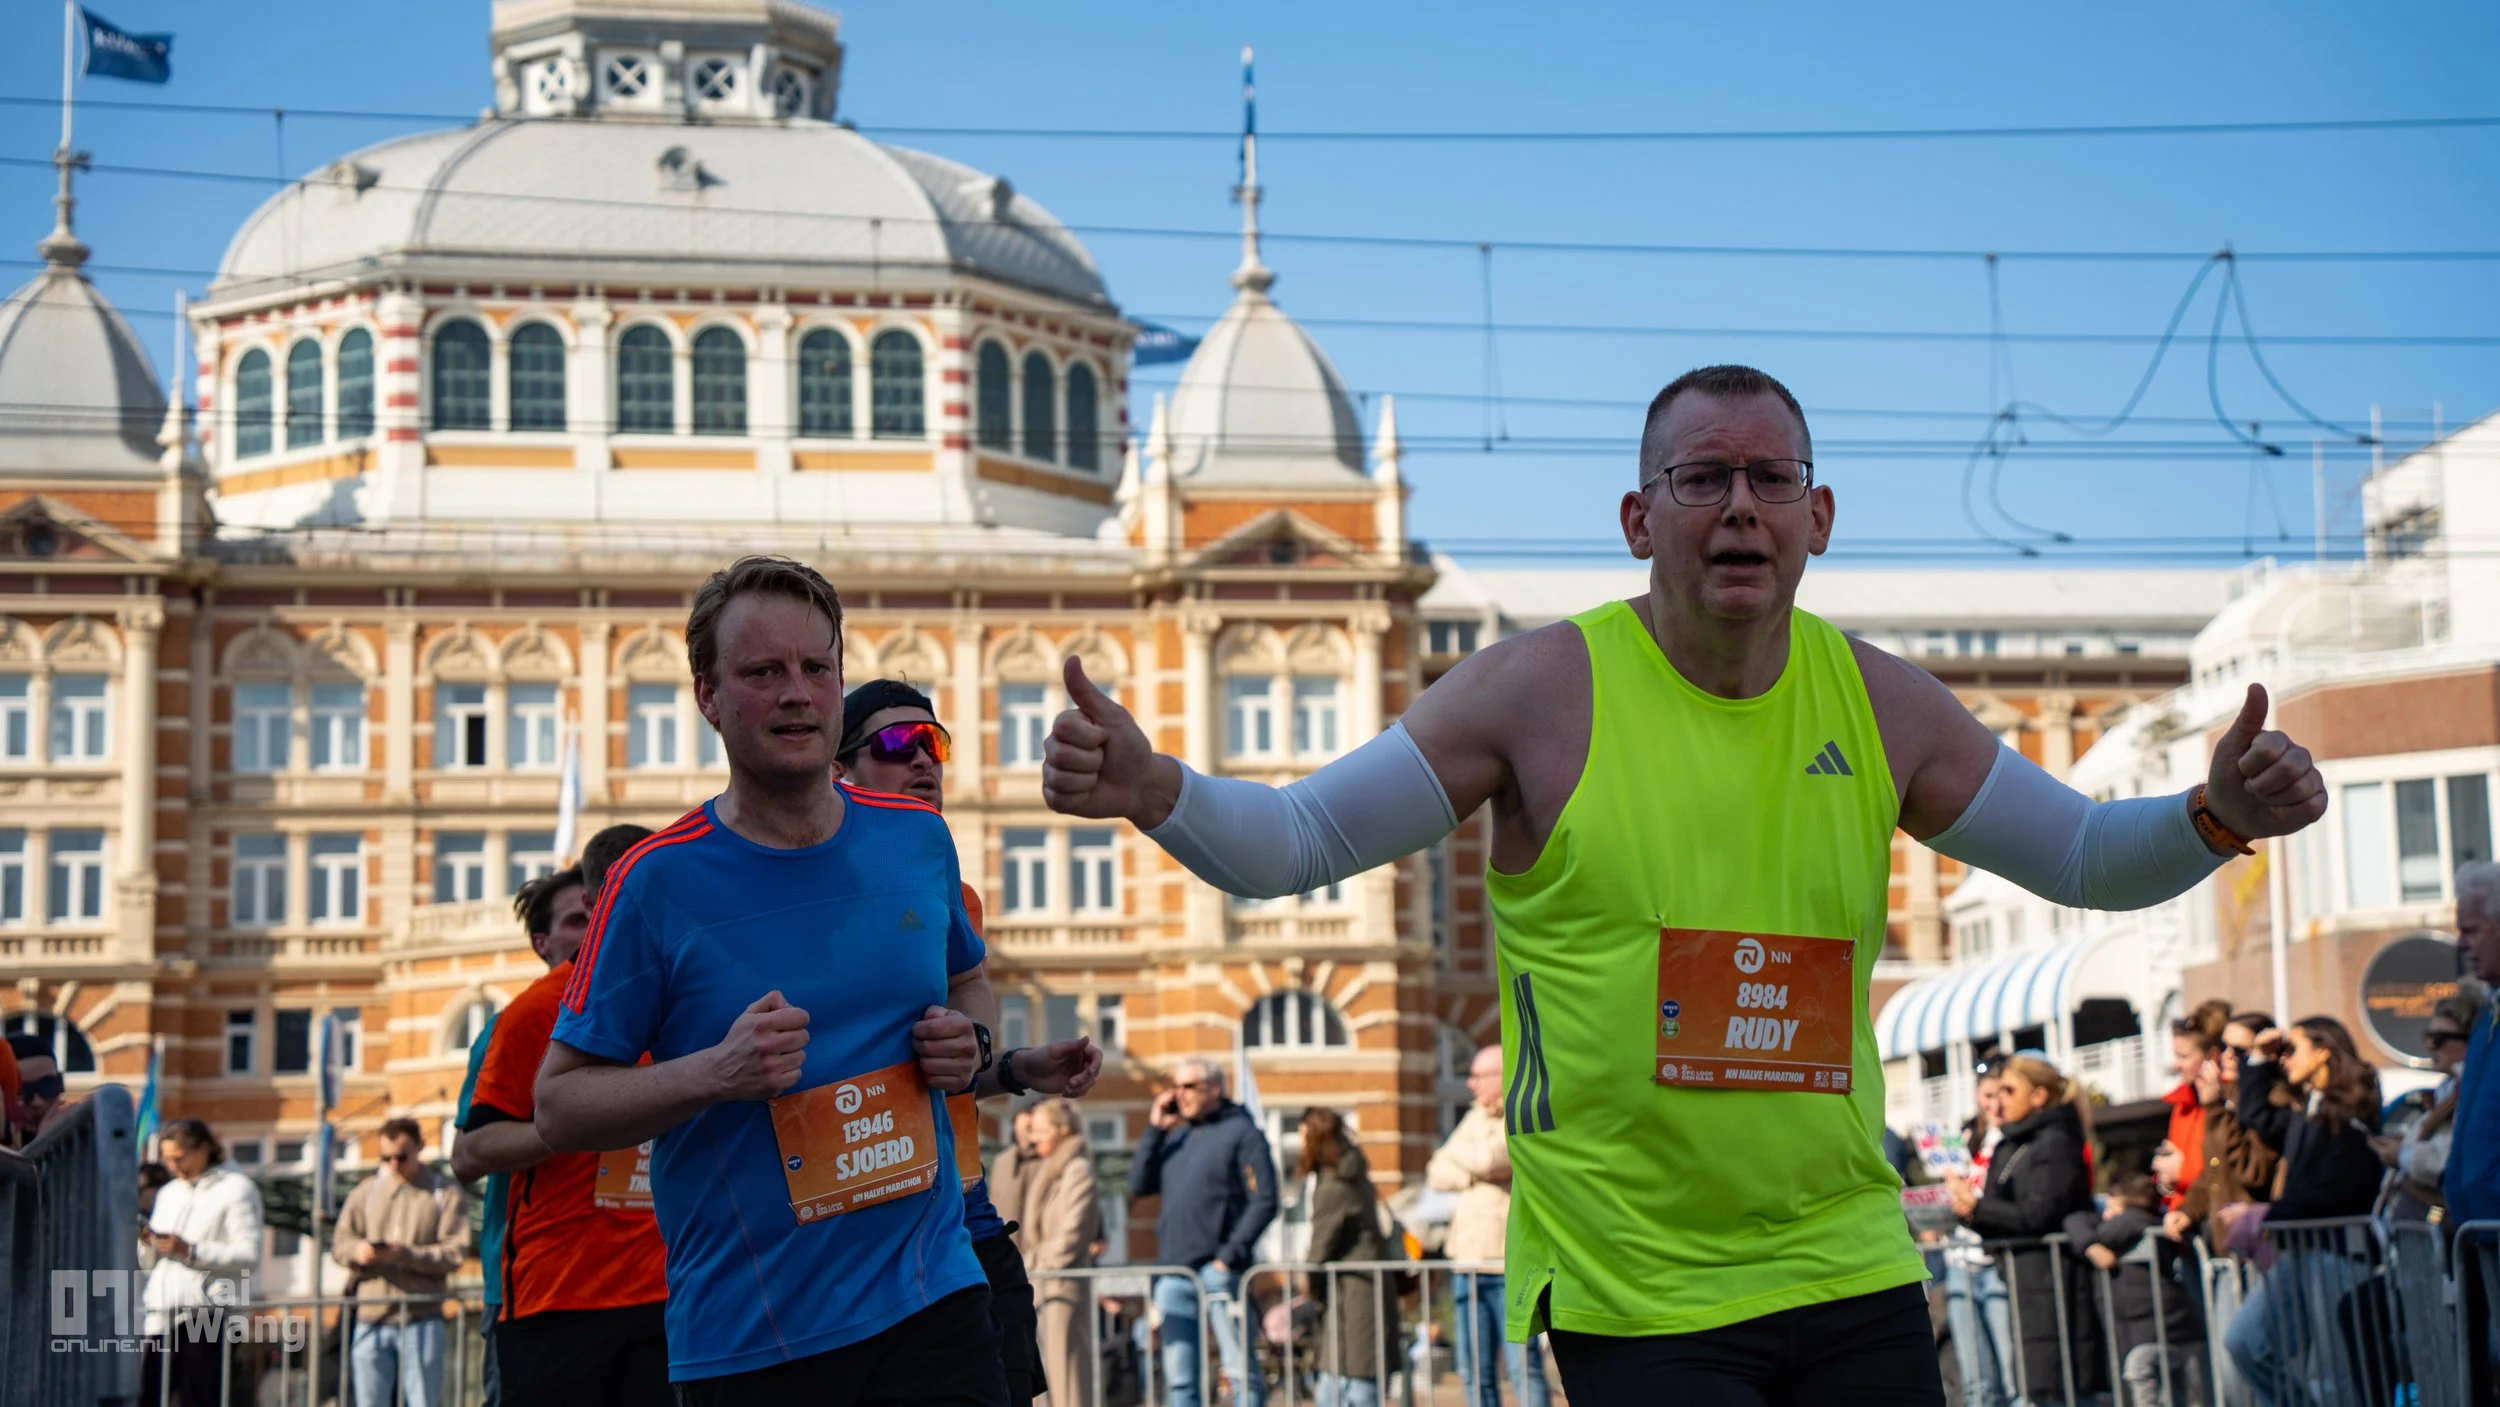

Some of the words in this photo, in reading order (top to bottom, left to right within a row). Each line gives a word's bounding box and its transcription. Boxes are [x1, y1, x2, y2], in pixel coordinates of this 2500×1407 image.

[1771, 951, 1792, 964] NN
[1736, 981, 1789, 1010] 8984
[1724, 1015, 1800, 1052] RUDY
[1725, 1068, 1738, 1079] NN
[1738, 1069, 1764, 1081] HALVE
[1764, 1069, 1805, 1083] MARATHON
[865, 1083, 886, 1098] NN
[842, 1110, 895, 1145] 13946
[836, 1135, 914, 1181] SJOERD
[852, 1192, 864, 1204] NN
[864, 1186, 885, 1200] HALVE
[885, 1175, 922, 1194] MARATHON
